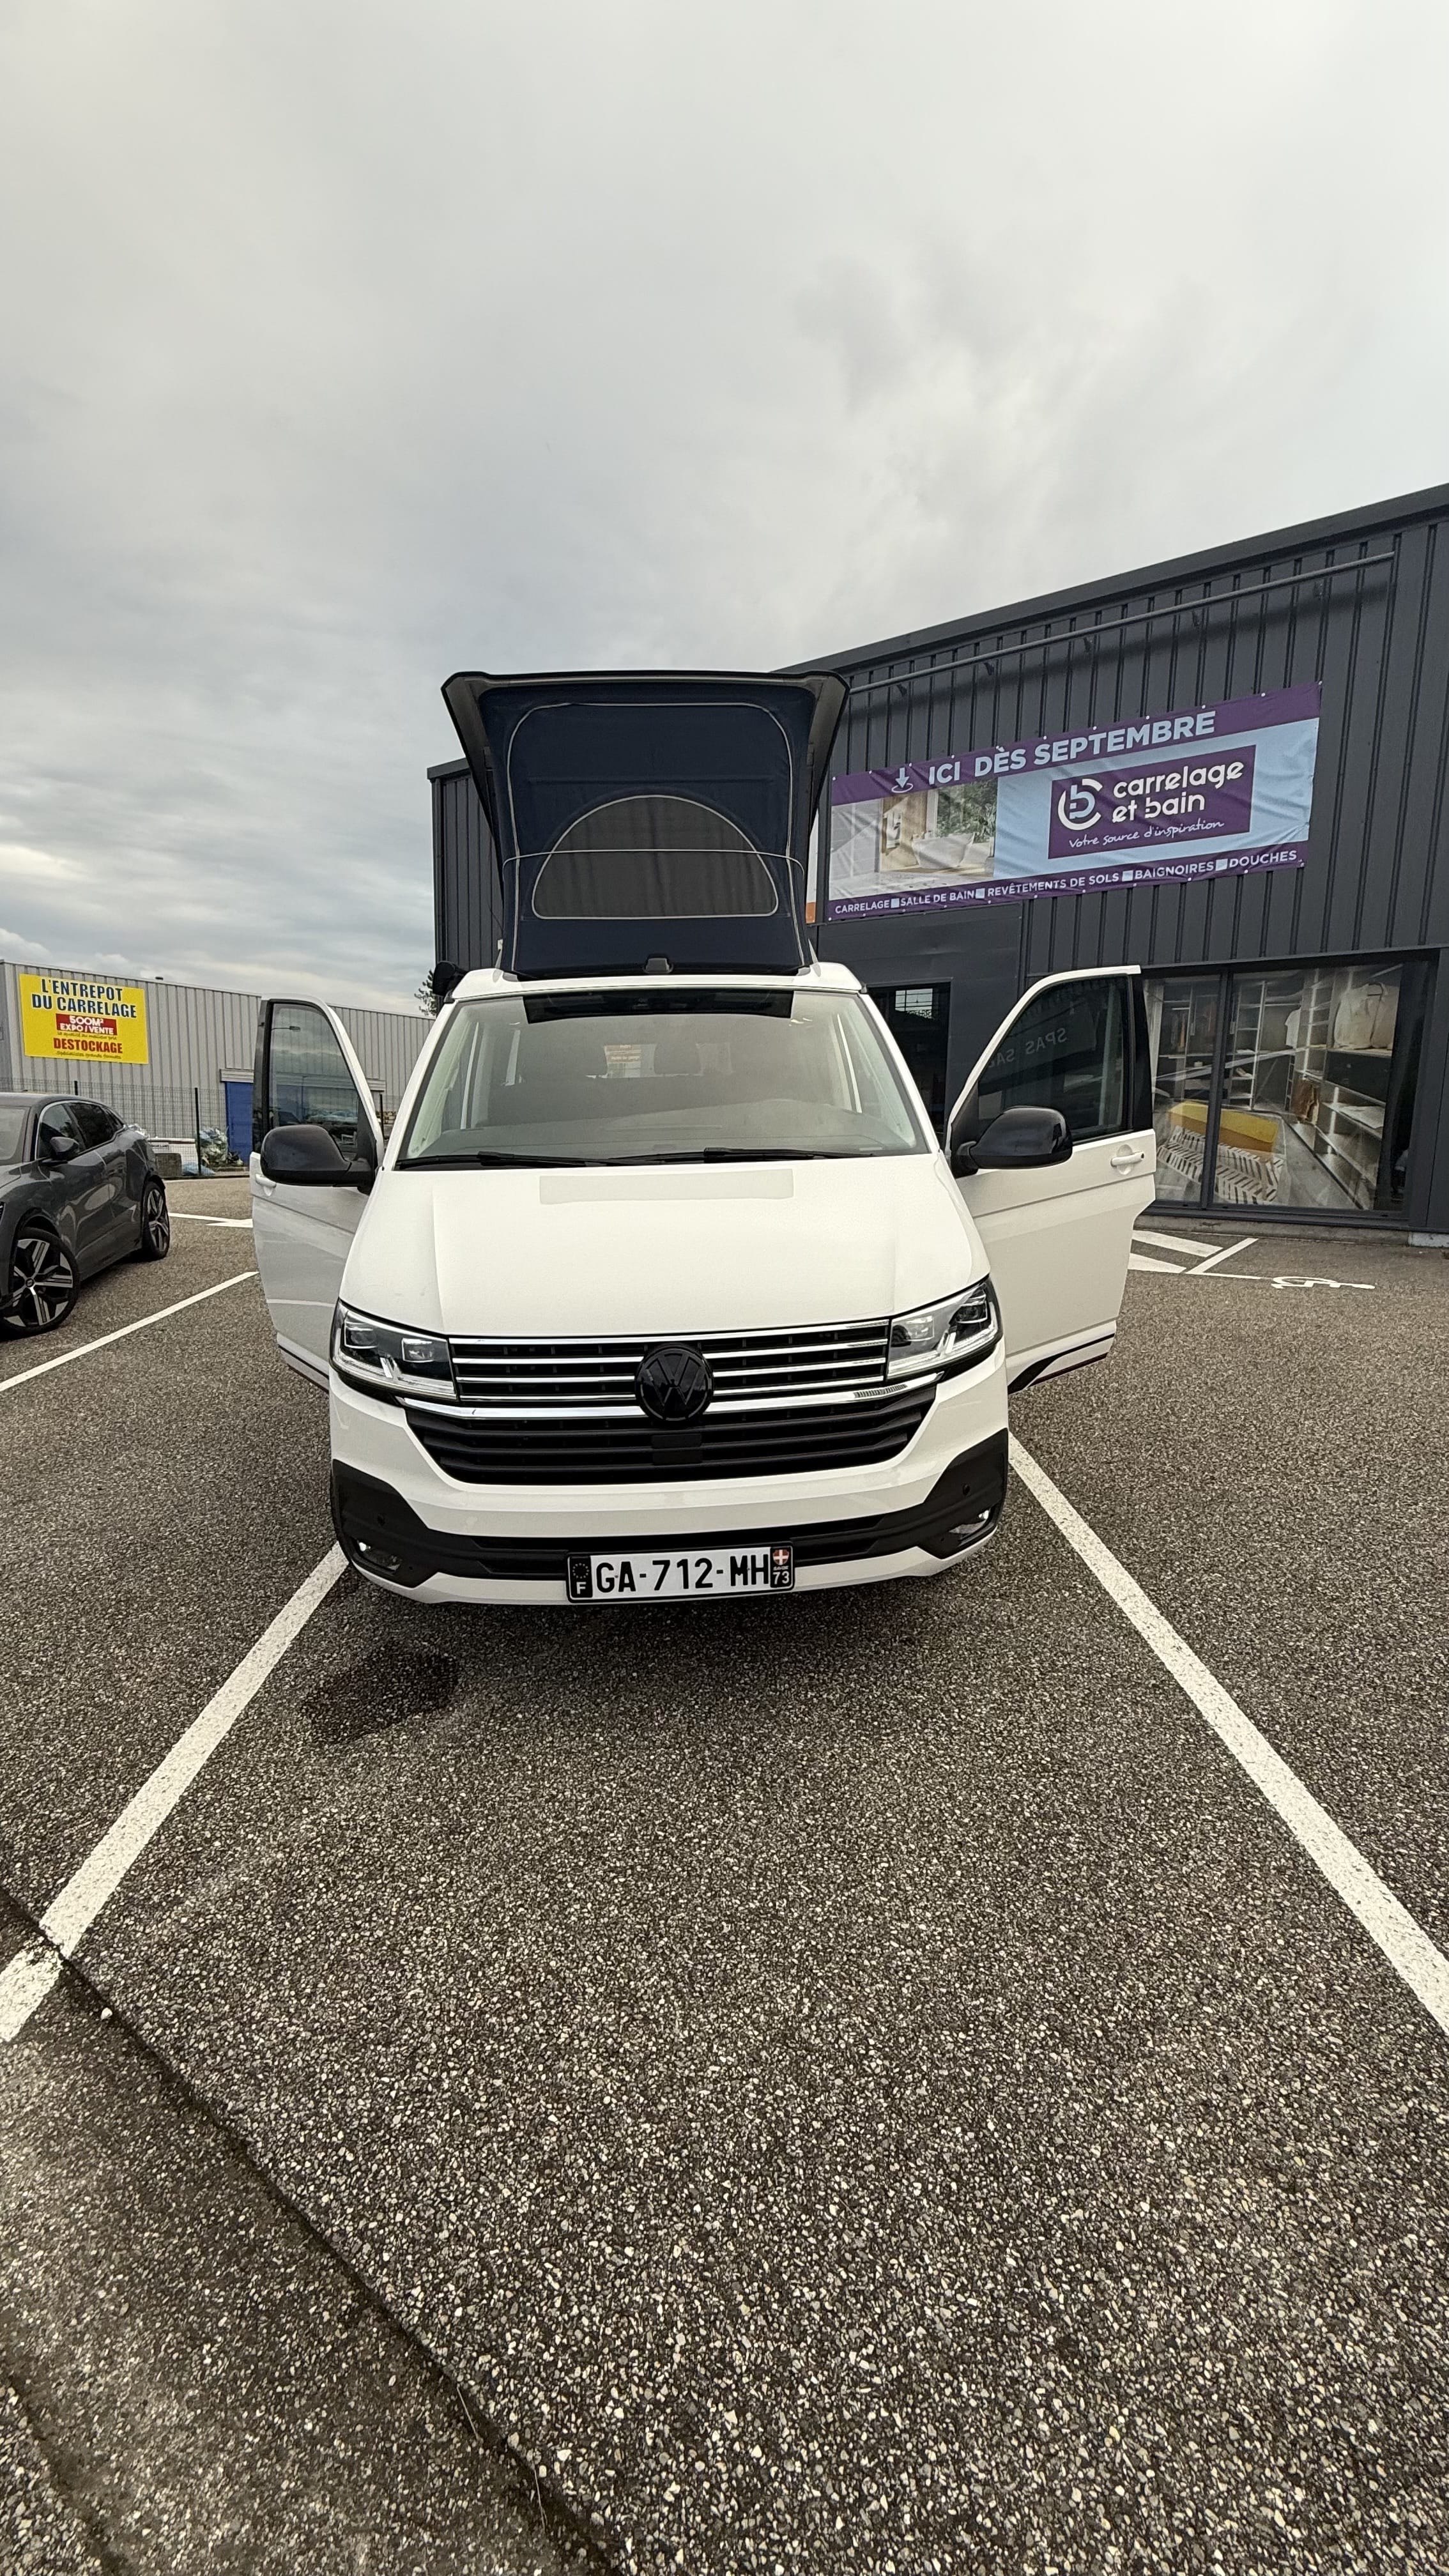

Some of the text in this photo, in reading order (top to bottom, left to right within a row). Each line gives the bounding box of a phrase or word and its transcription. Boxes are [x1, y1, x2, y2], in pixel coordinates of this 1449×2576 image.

[928, 710, 1216, 785] ICI DÈS SEPTEMBRE
[1113, 761, 1245, 799] carrelage
[1112, 791, 1205, 824] et bain
[1068, 817, 1225, 848] Votre source d'inspiration
[834, 850, 1298, 914] CARRELAGE SALLE DE BAIN REVÊTEMENTS DE SOLS BAIGNOIRES DOUCHES
[41, 979, 123, 1002] L'ENTREPOT
[31, 993, 137, 1018] DU CARRELAGE
[59, 1023, 84, 1032] EXPO
[88, 1025, 114, 1035] VENTE
[53, 1037, 123, 1054] DESTOCKAGE
[595, 1553, 769, 1593] GA-712-MH
[772, 1570, 790, 1585] 73
[576, 1581, 586, 1595] F
